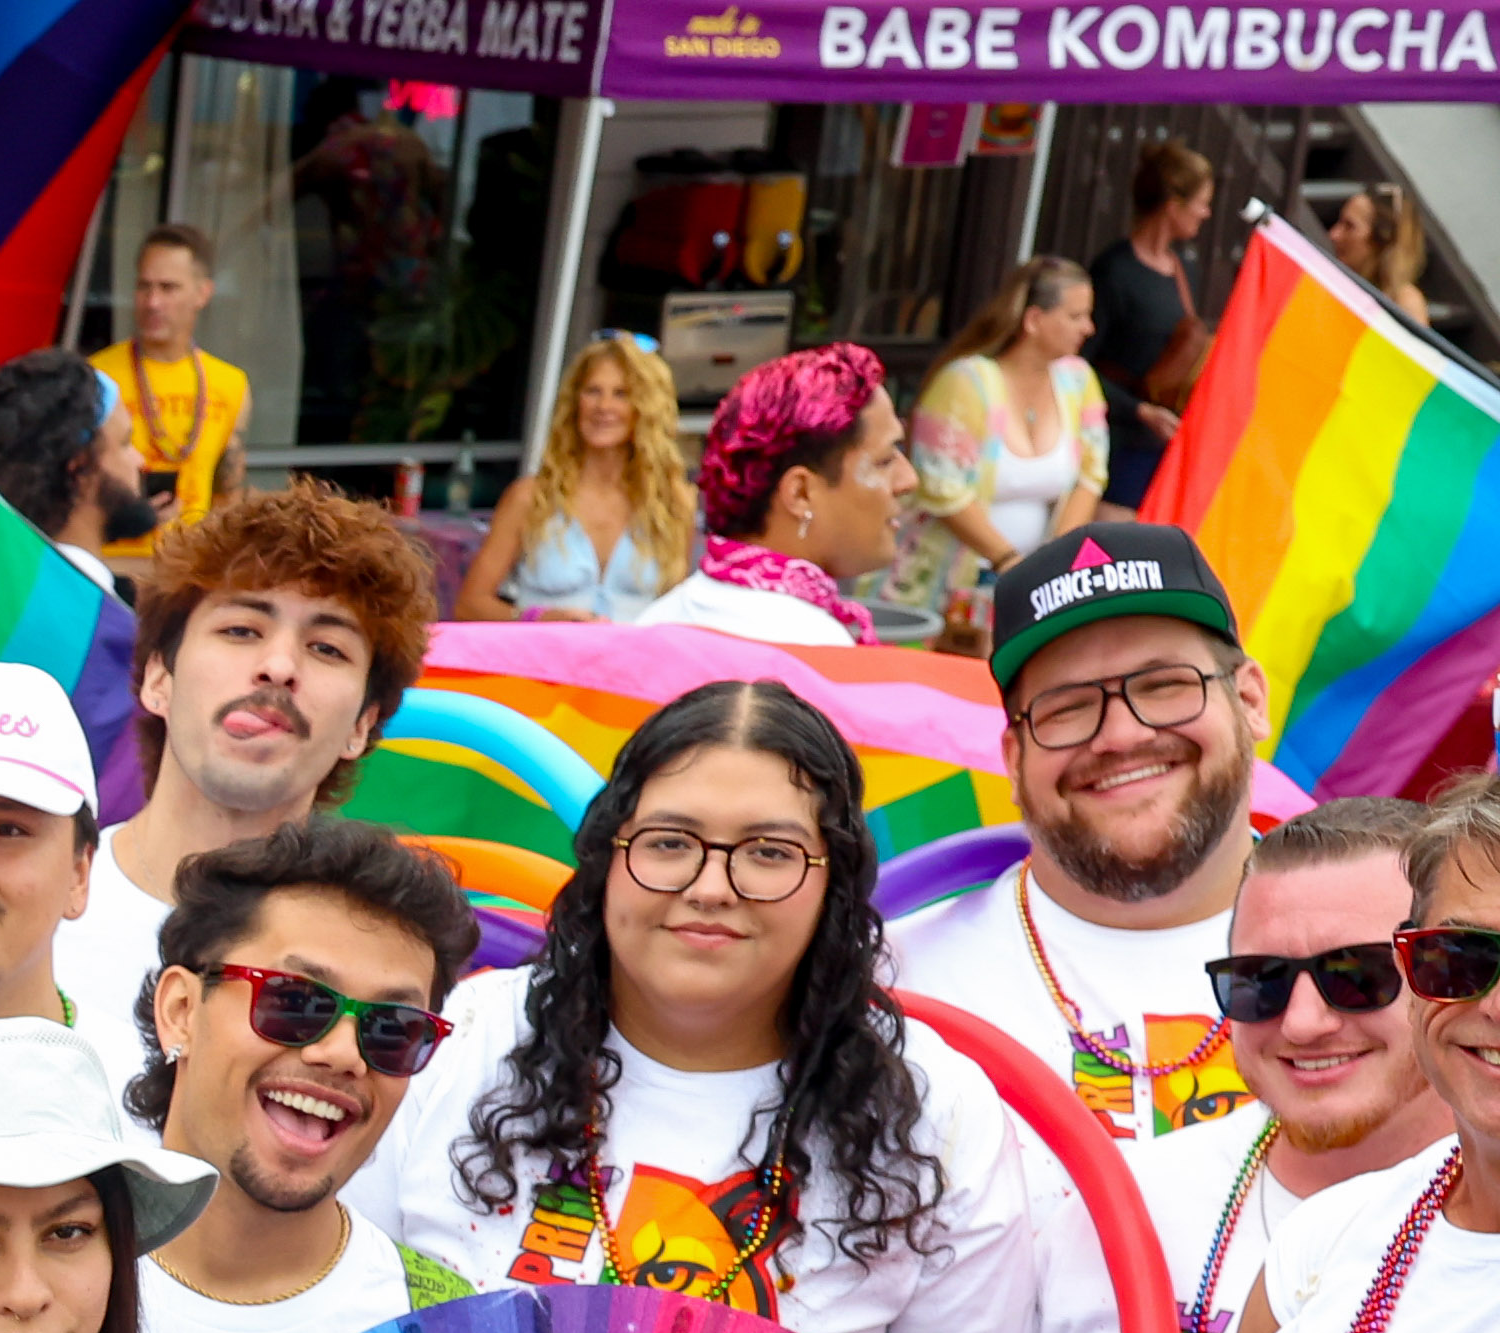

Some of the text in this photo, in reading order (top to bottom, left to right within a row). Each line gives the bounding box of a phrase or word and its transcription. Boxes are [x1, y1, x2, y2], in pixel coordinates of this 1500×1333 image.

[361, 0, 466, 56] YERBA
[477, 0, 588, 63] MATE
[664, 36, 781, 58] SAN DIEGO
[819, 5, 1497, 72] BABE KOMBUCHA
[1030, 560, 1164, 620] SILENCE=DEATH
